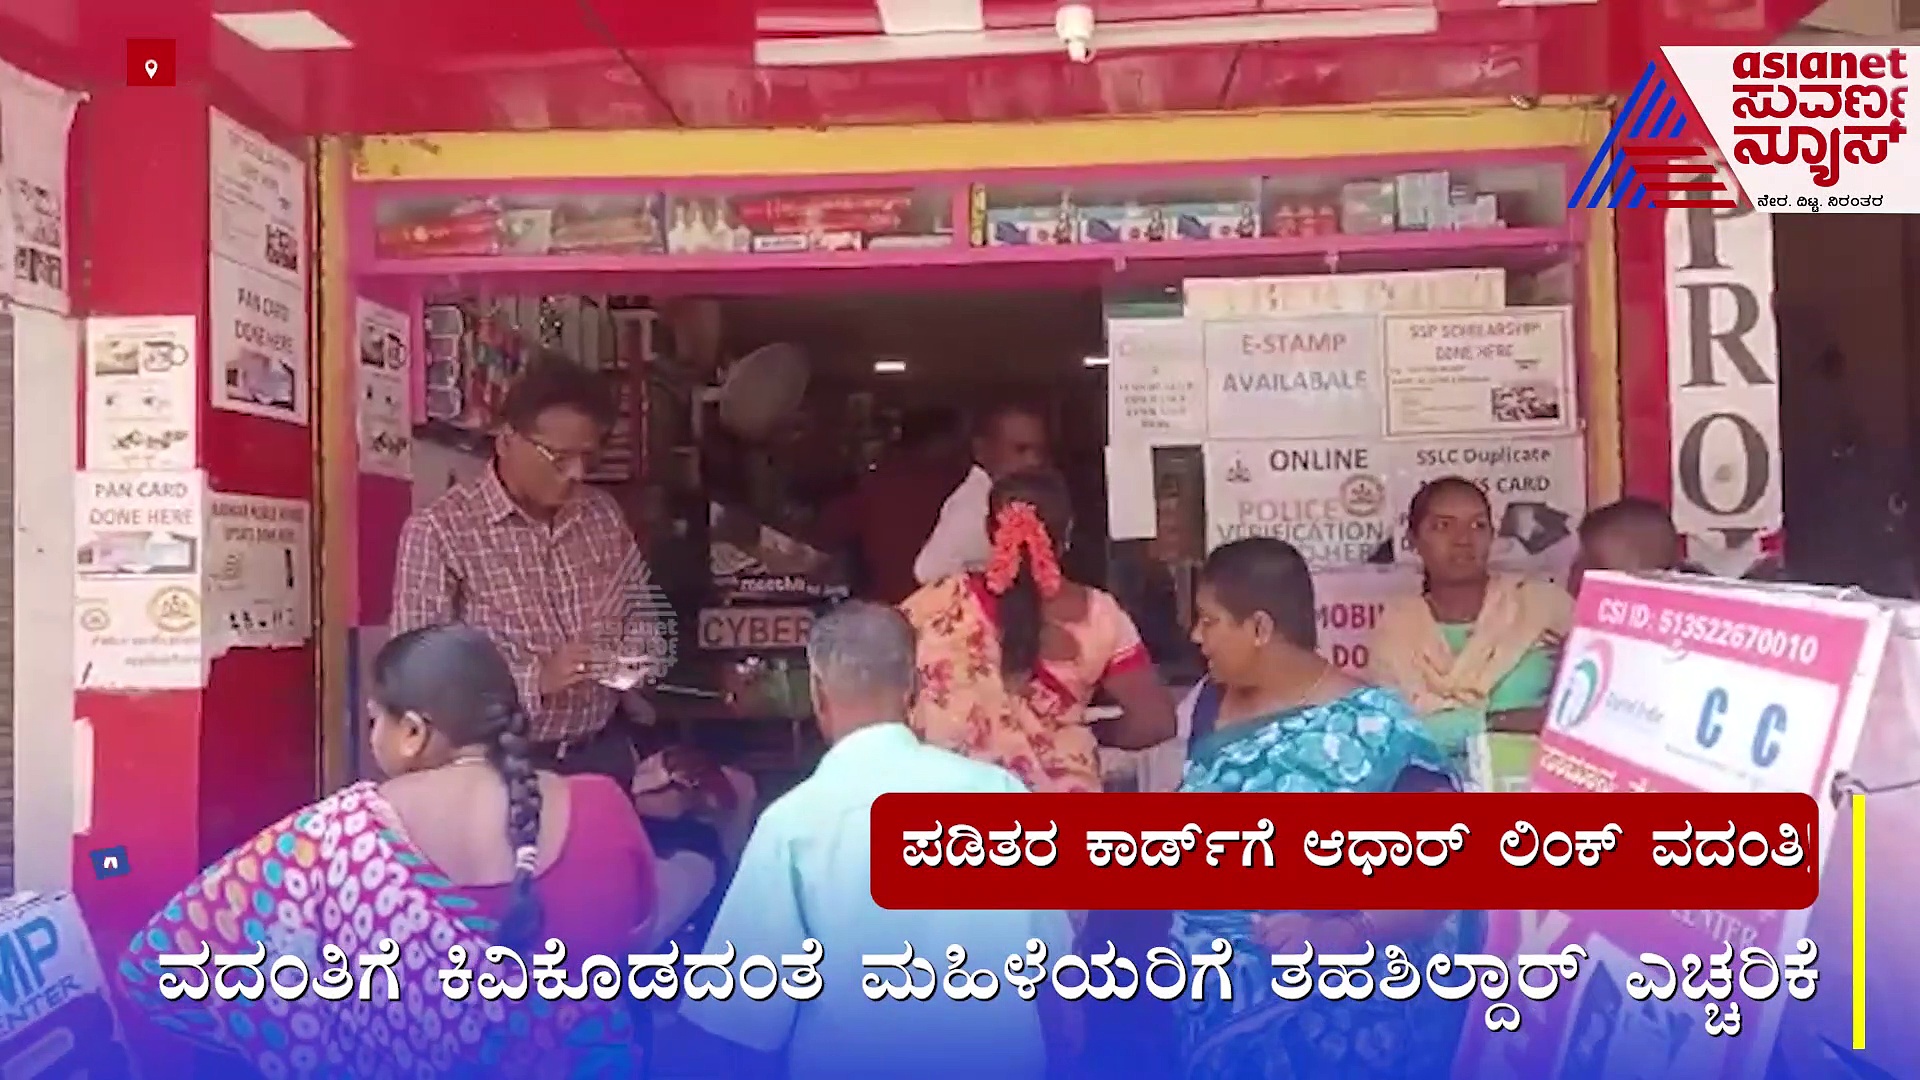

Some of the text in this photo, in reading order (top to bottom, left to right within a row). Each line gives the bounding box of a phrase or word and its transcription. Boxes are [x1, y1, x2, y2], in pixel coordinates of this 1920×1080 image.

[1241, 332, 1347, 355] E-STAMP
[1223, 369, 1368, 393] AVAILABALE
[1269, 448, 1369, 472] ONLINE
[1416, 446, 1551, 467] SSLC Duplicate
[95, 480, 188, 499] PAN CARD
[1496, 475, 1551, 494] CARD
[89, 507, 141, 526] DONE
[148, 507, 193, 526] HERE
[1238, 498, 1340, 525] POLICE
[1316, 603, 1385, 630] OBI
[1658, 608, 1820, 666] 513522670010
